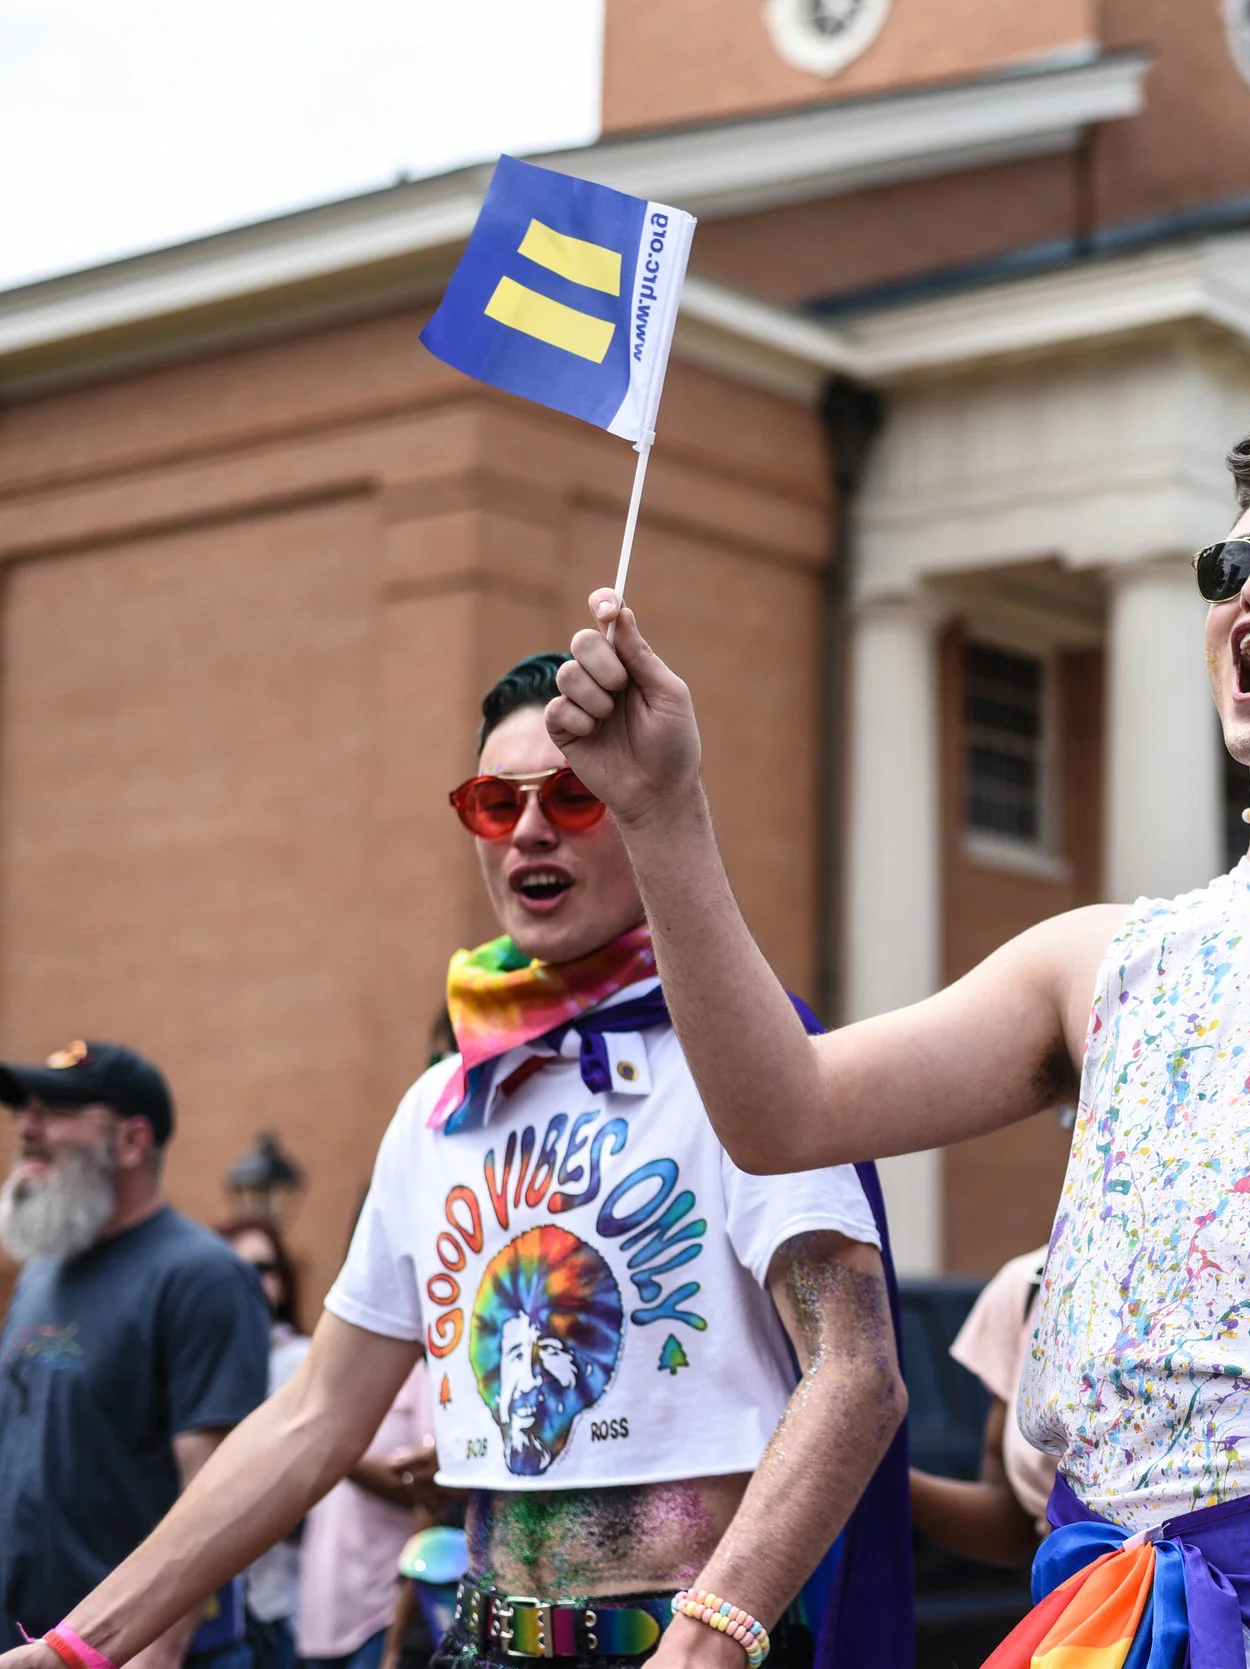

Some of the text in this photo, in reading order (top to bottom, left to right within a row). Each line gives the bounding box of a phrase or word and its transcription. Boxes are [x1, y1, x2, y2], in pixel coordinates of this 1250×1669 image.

[427, 1110, 707, 1358] GOOD VIBES ONLY
[590, 1417, 630, 1442] ROSS
